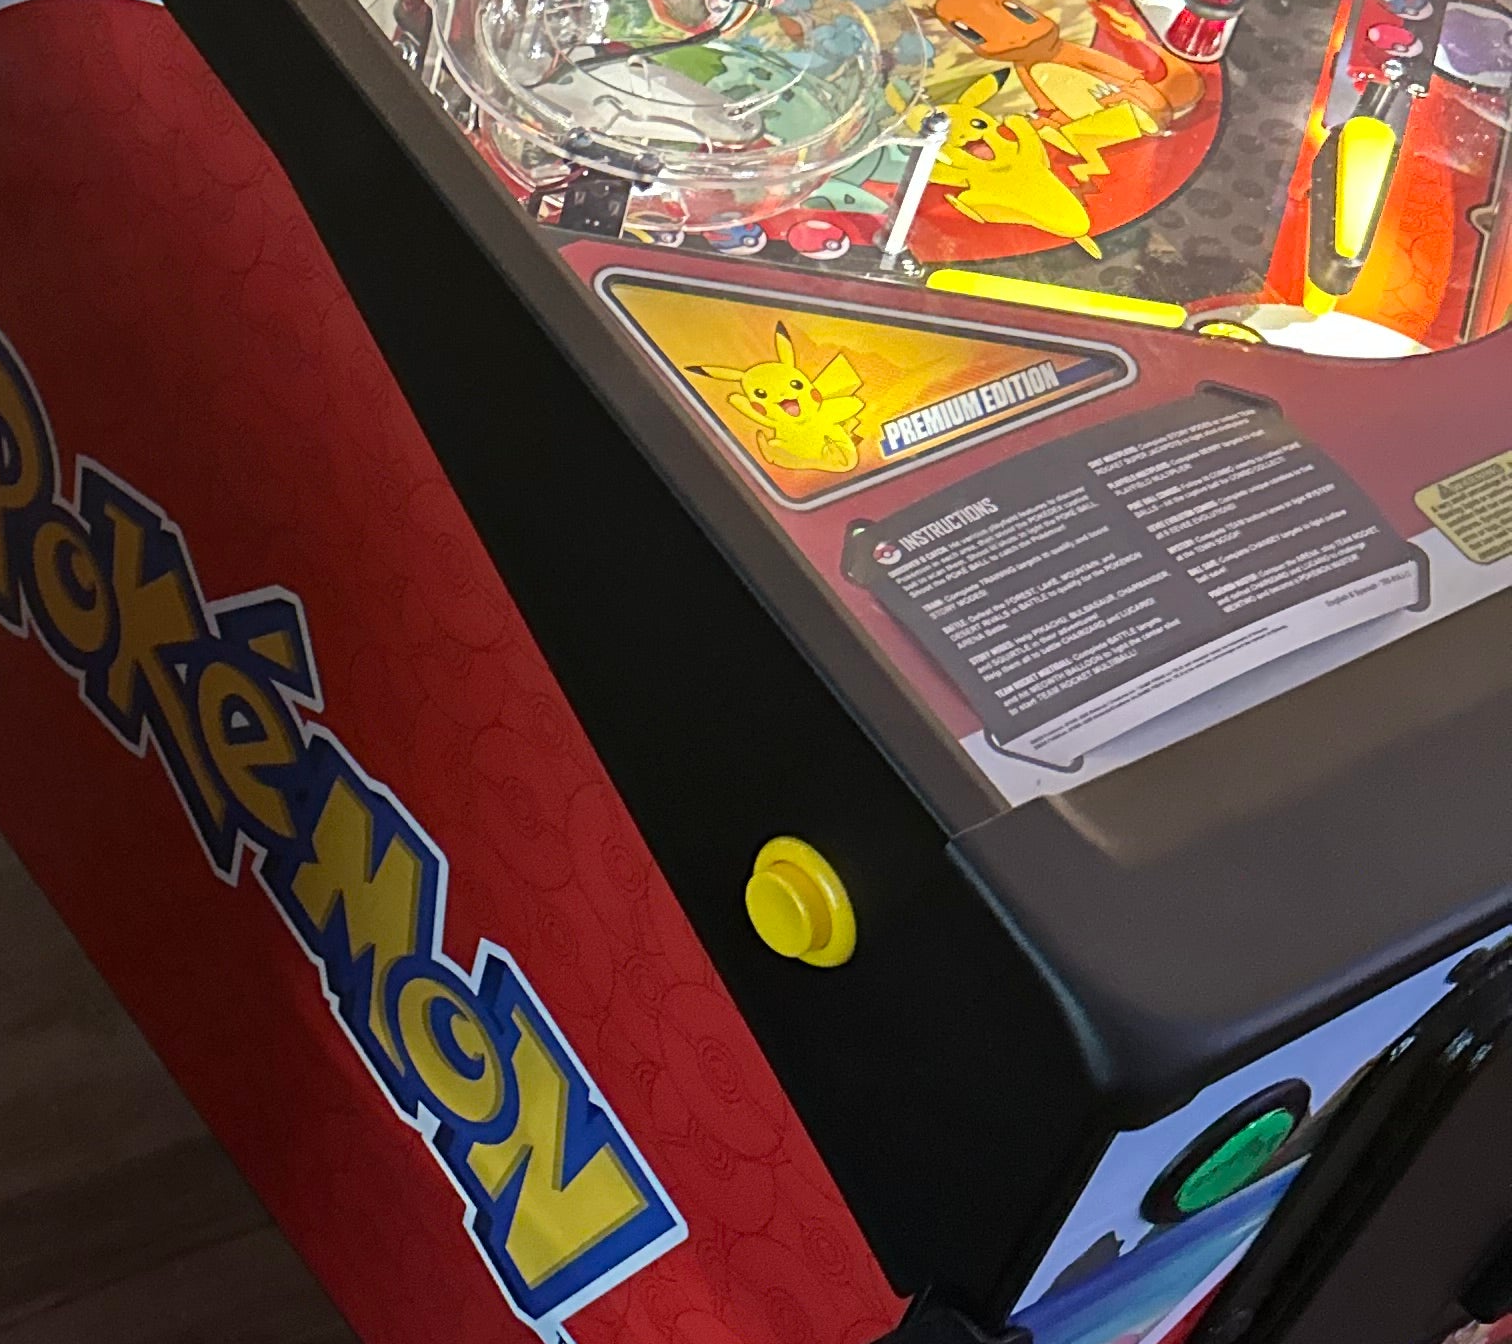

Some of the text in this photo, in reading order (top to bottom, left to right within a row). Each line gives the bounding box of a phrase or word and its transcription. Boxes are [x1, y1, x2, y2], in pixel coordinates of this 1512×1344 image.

[884, 362, 1060, 450] PREMIUM EDITION
[899, 497, 999, 552] INSTRUCTIONS
